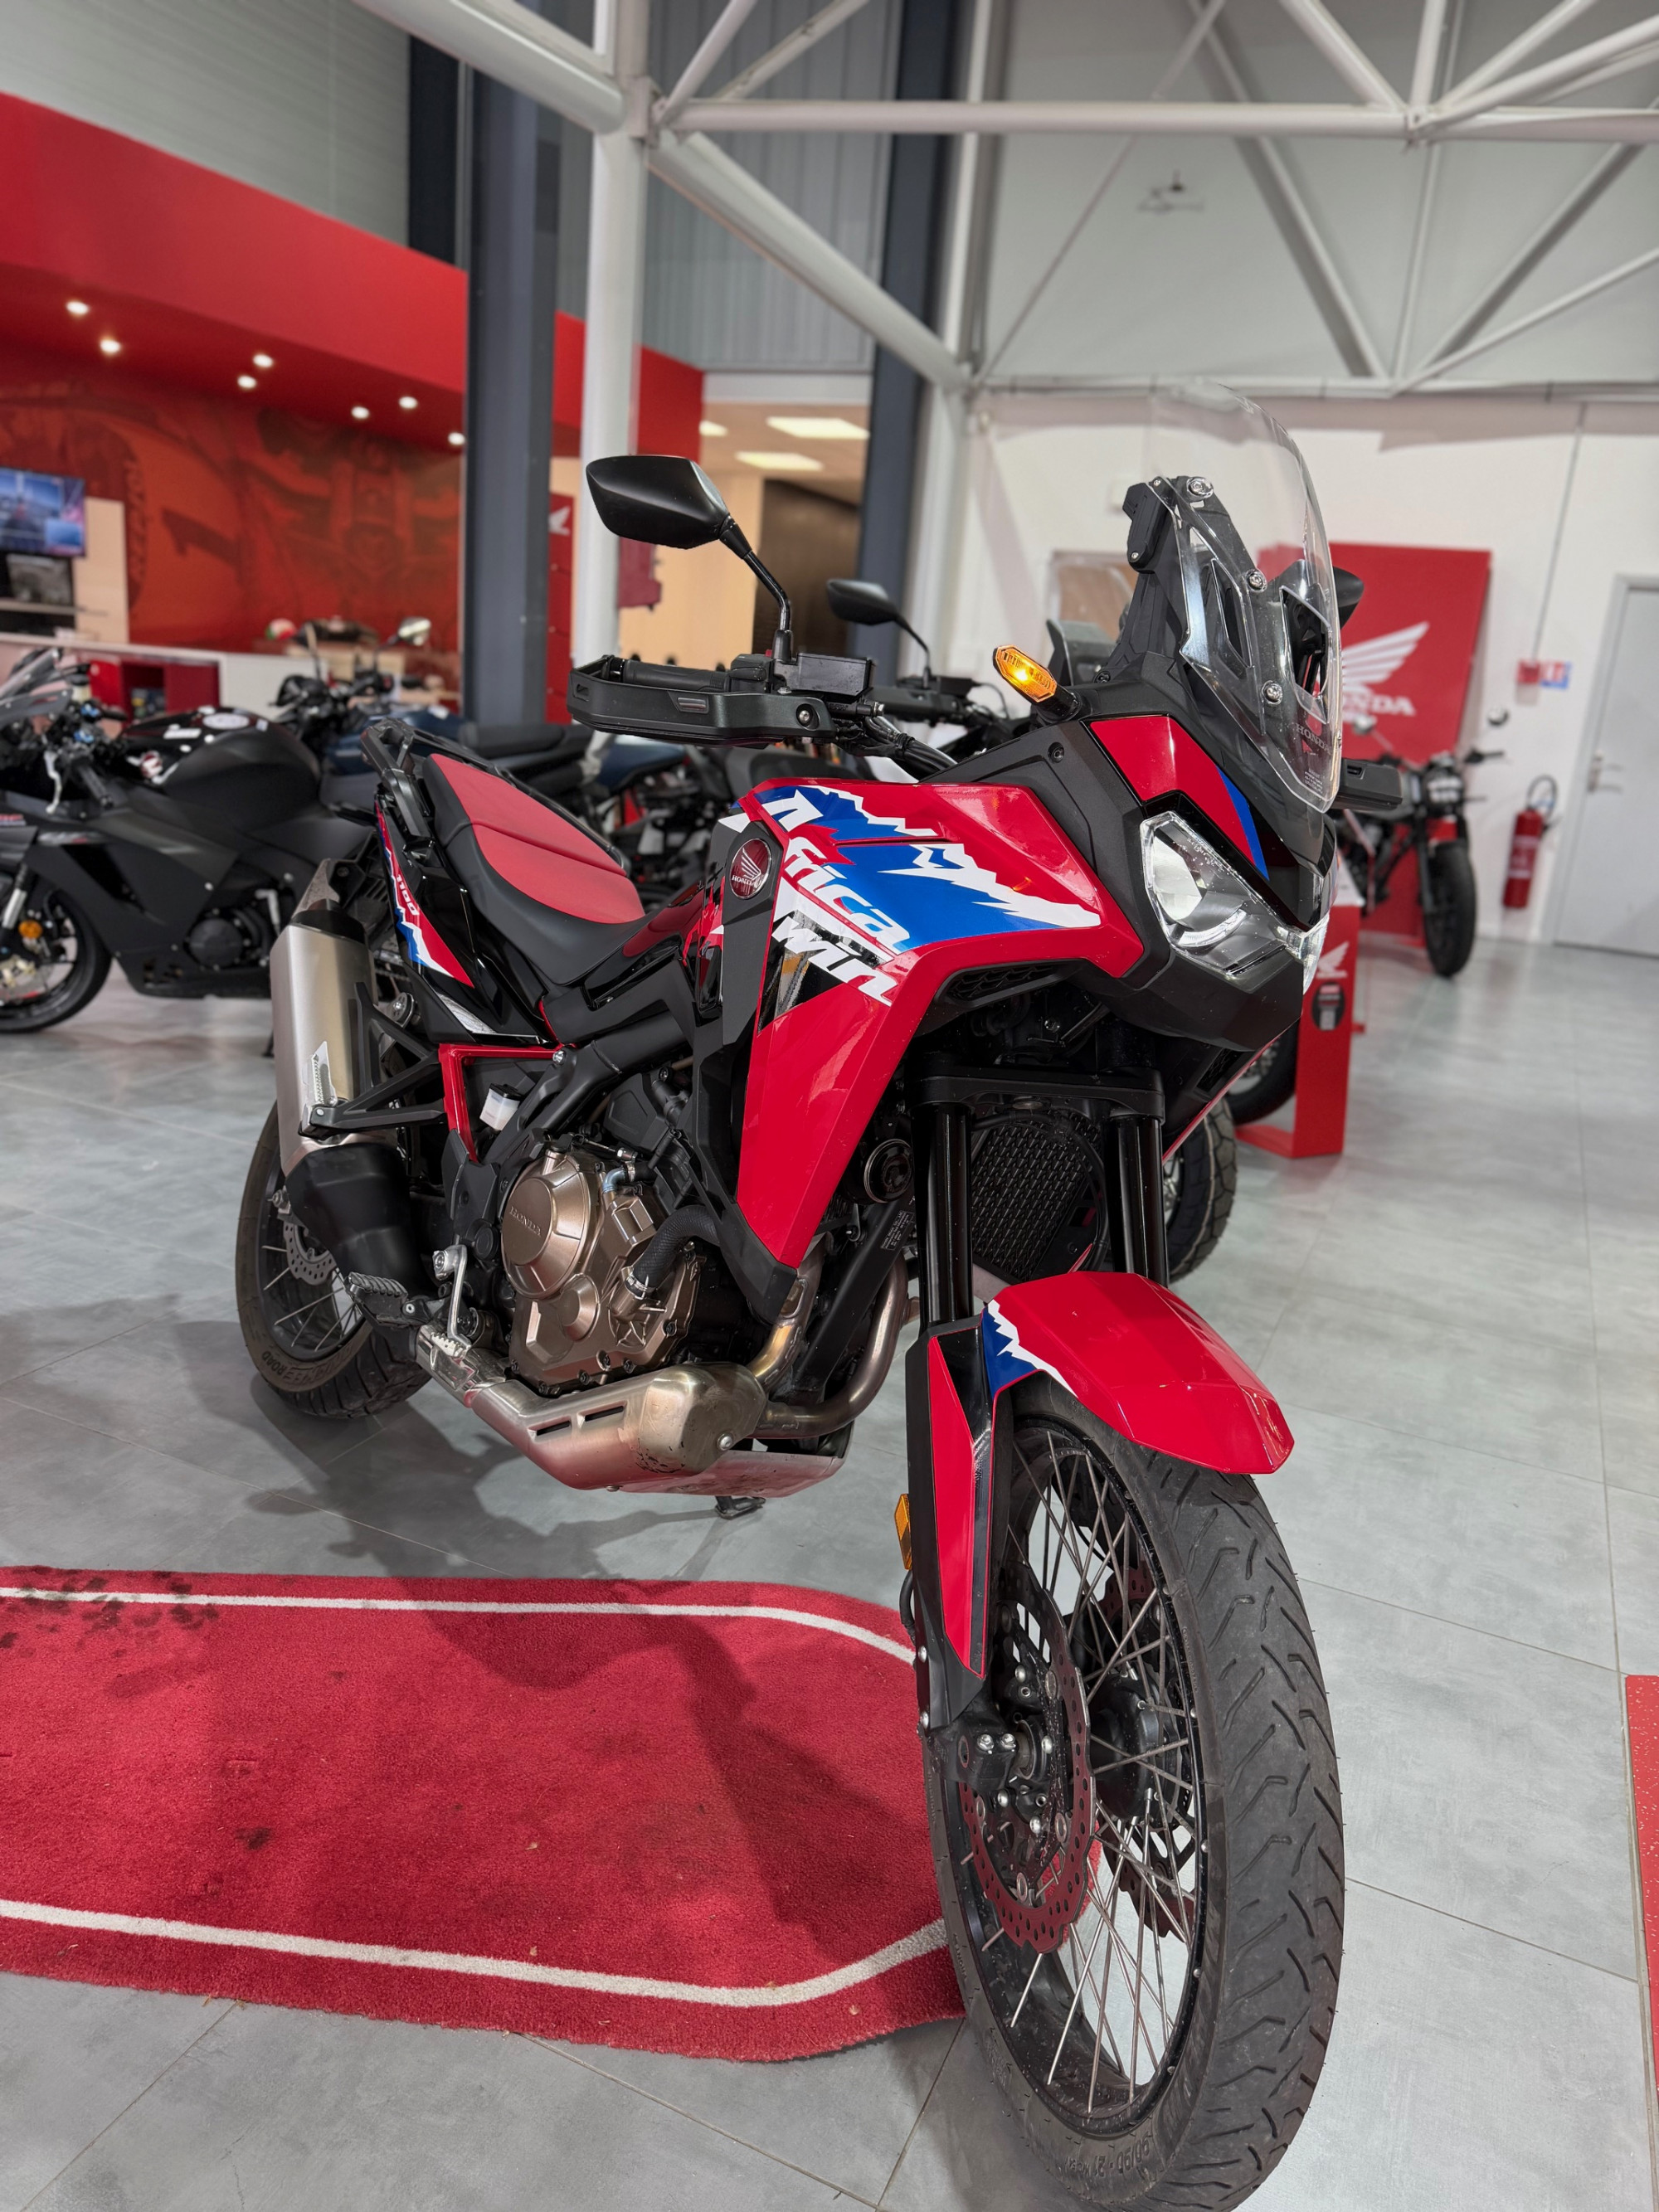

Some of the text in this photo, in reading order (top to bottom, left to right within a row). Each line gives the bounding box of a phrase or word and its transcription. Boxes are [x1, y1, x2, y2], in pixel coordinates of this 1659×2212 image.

[1341, 693, 1416, 717] NDA
[761, 789, 910, 955] Africa
[397, 874, 420, 916] 1100
[509, 1206, 541, 1236] HONDA
[262, 1351, 288, 1375] ROAD
